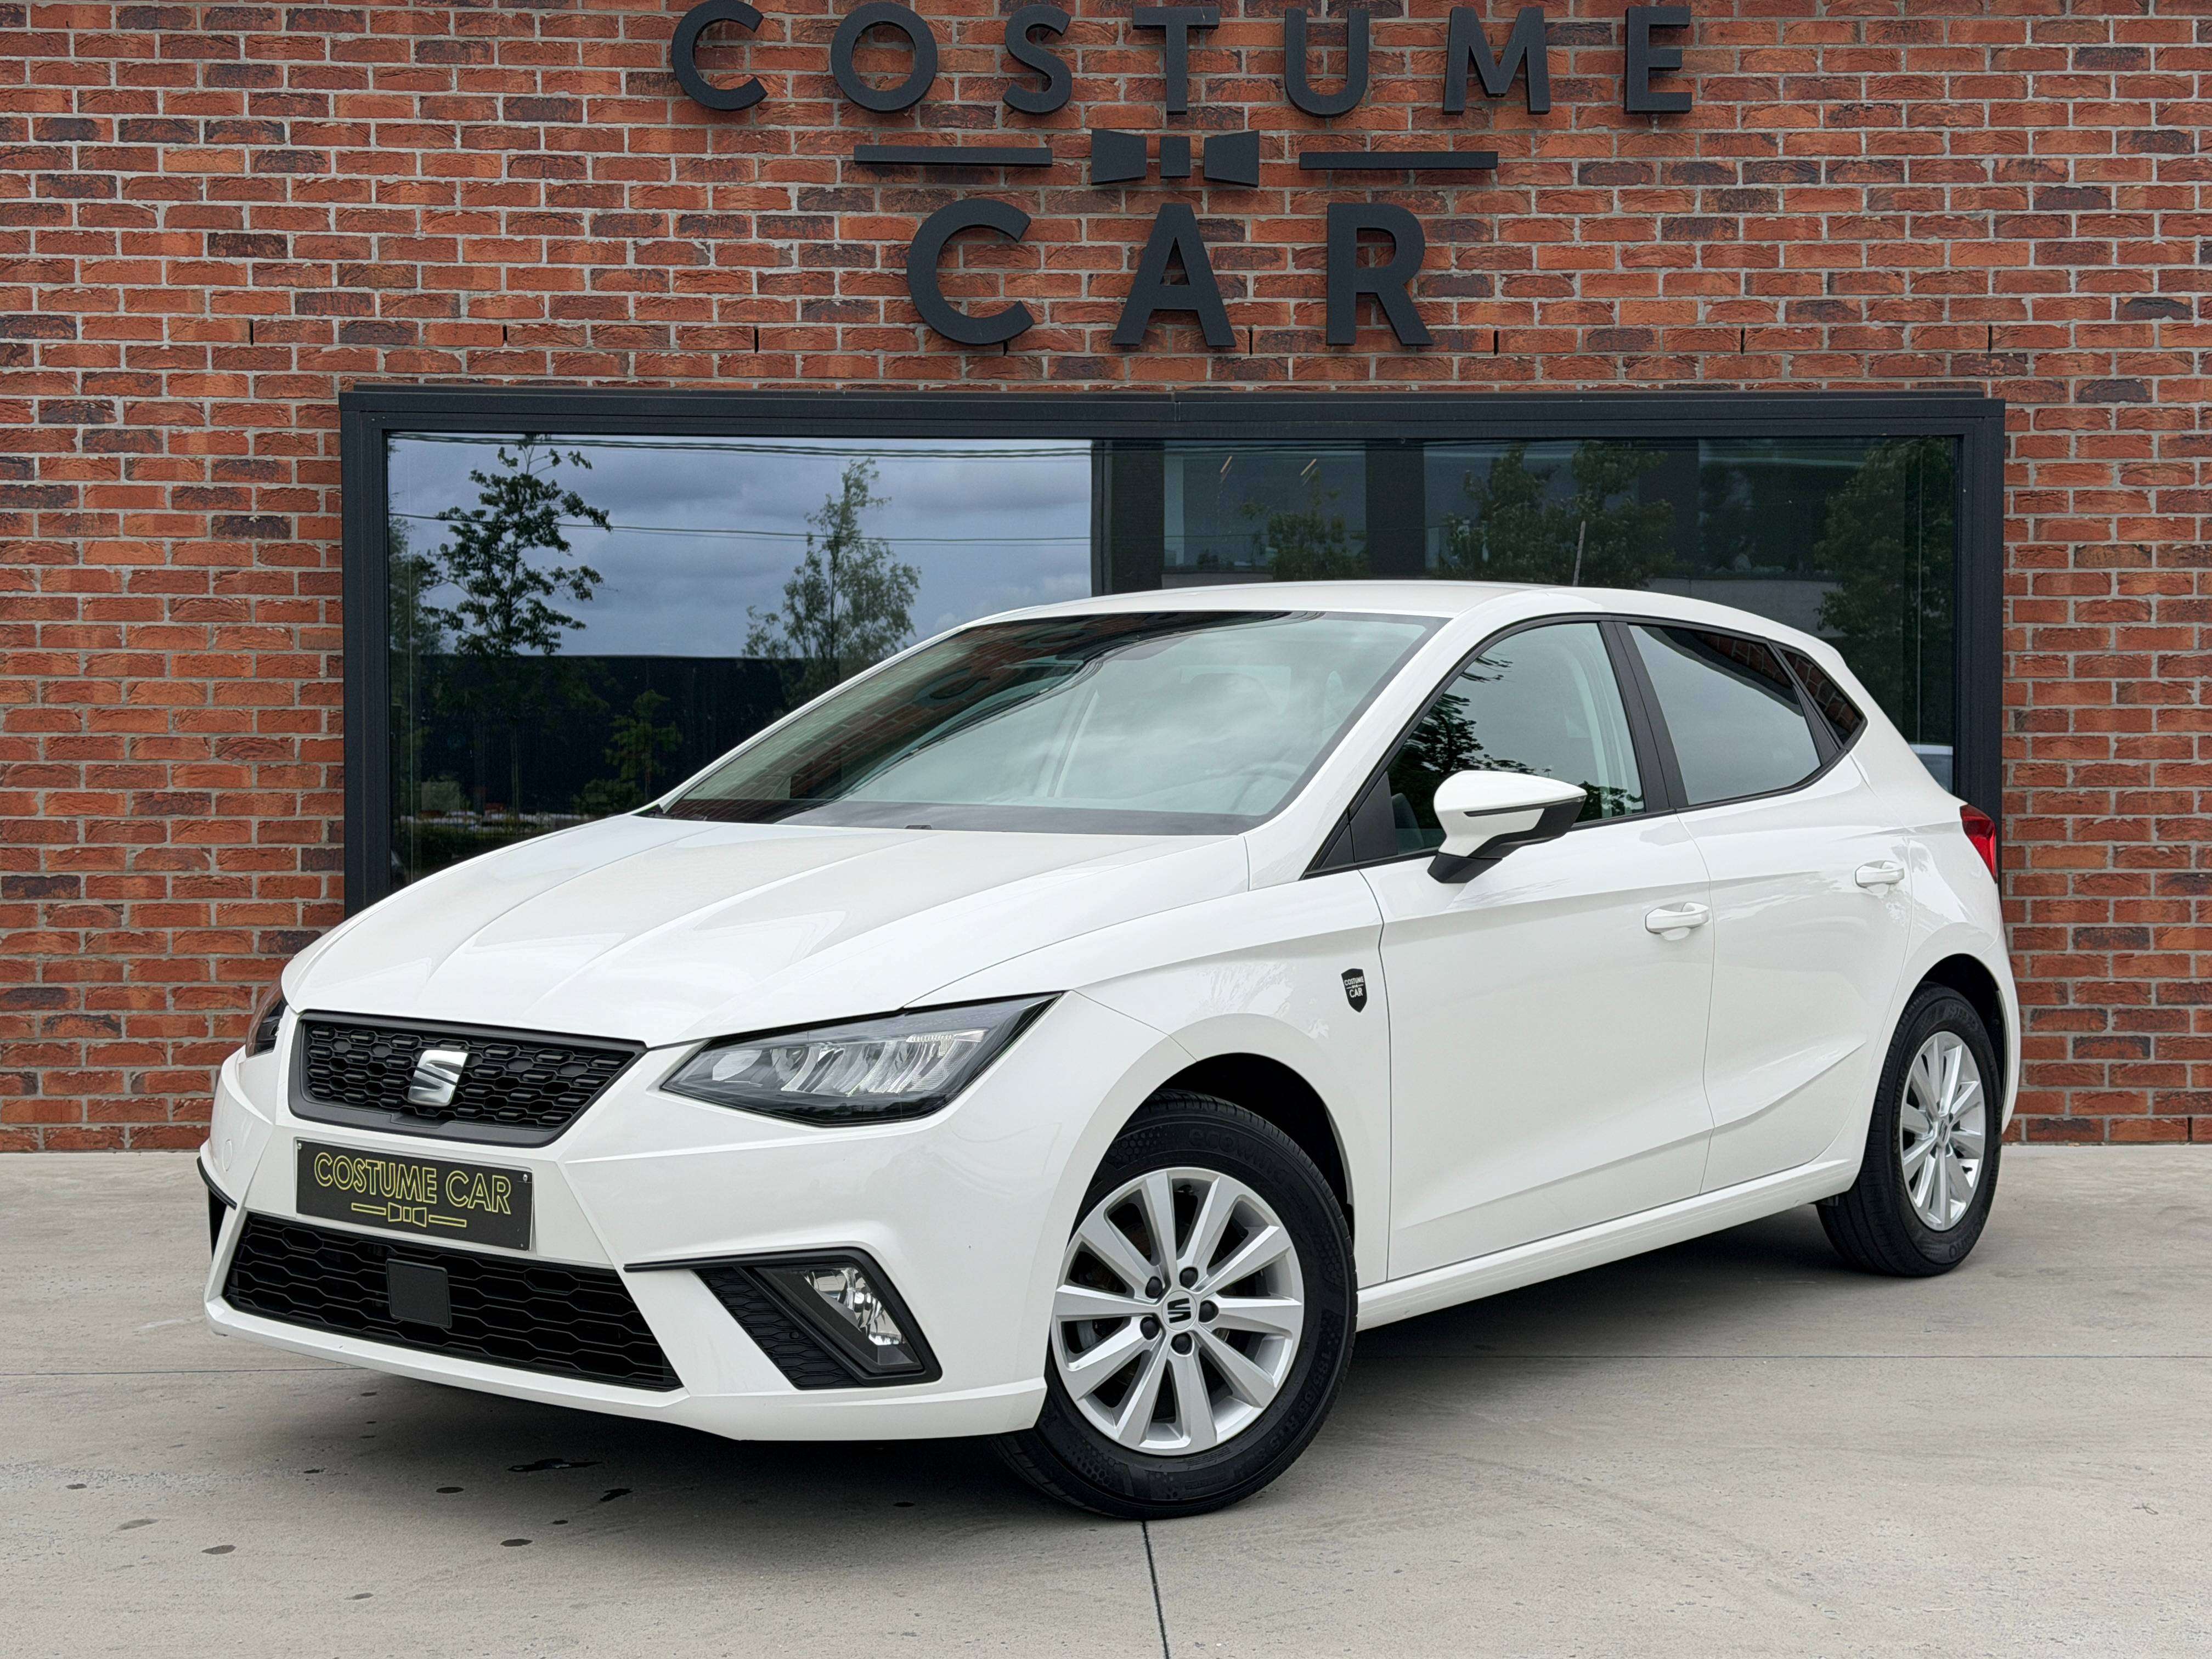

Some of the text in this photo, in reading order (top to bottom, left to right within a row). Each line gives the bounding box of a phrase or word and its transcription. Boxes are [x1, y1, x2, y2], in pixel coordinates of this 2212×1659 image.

[672, 0, 1692, 114] COSTUME
[906, 199, 1434, 347] CAR
[1344, 977, 1364, 986] COSTUME
[1349, 987, 1363, 998] CAR
[314, 1152, 511, 1215] COSTUME CAR
